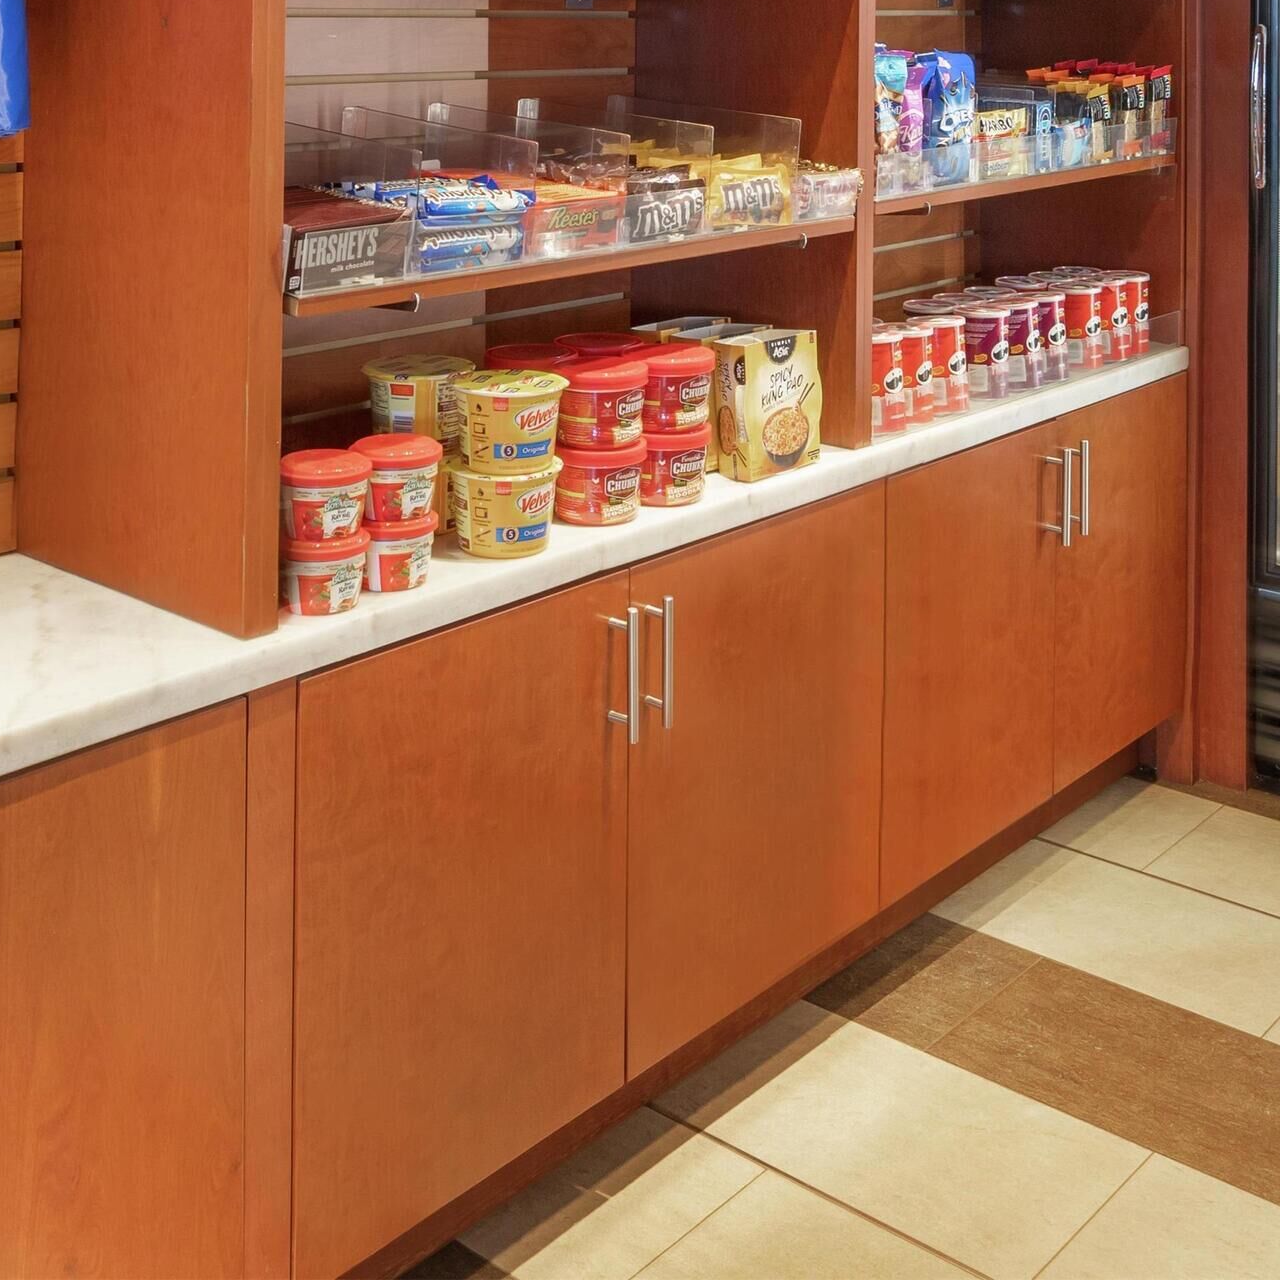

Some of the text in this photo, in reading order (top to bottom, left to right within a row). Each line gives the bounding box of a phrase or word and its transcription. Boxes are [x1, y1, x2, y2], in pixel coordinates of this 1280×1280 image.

[1135, 84, 1145, 109] KIND
[1163, 74, 1171, 99] KIND
[1099, 95, 1111, 120] KIND
[549, 207, 600, 229] Reese's
[295, 227, 379, 270] HERSHEY'S
[769, 363, 794, 389] SPICY
[761, 373, 805, 409] KUNG PAO
[522, 445, 547, 455] Original
[523, 527, 546, 538] Original
